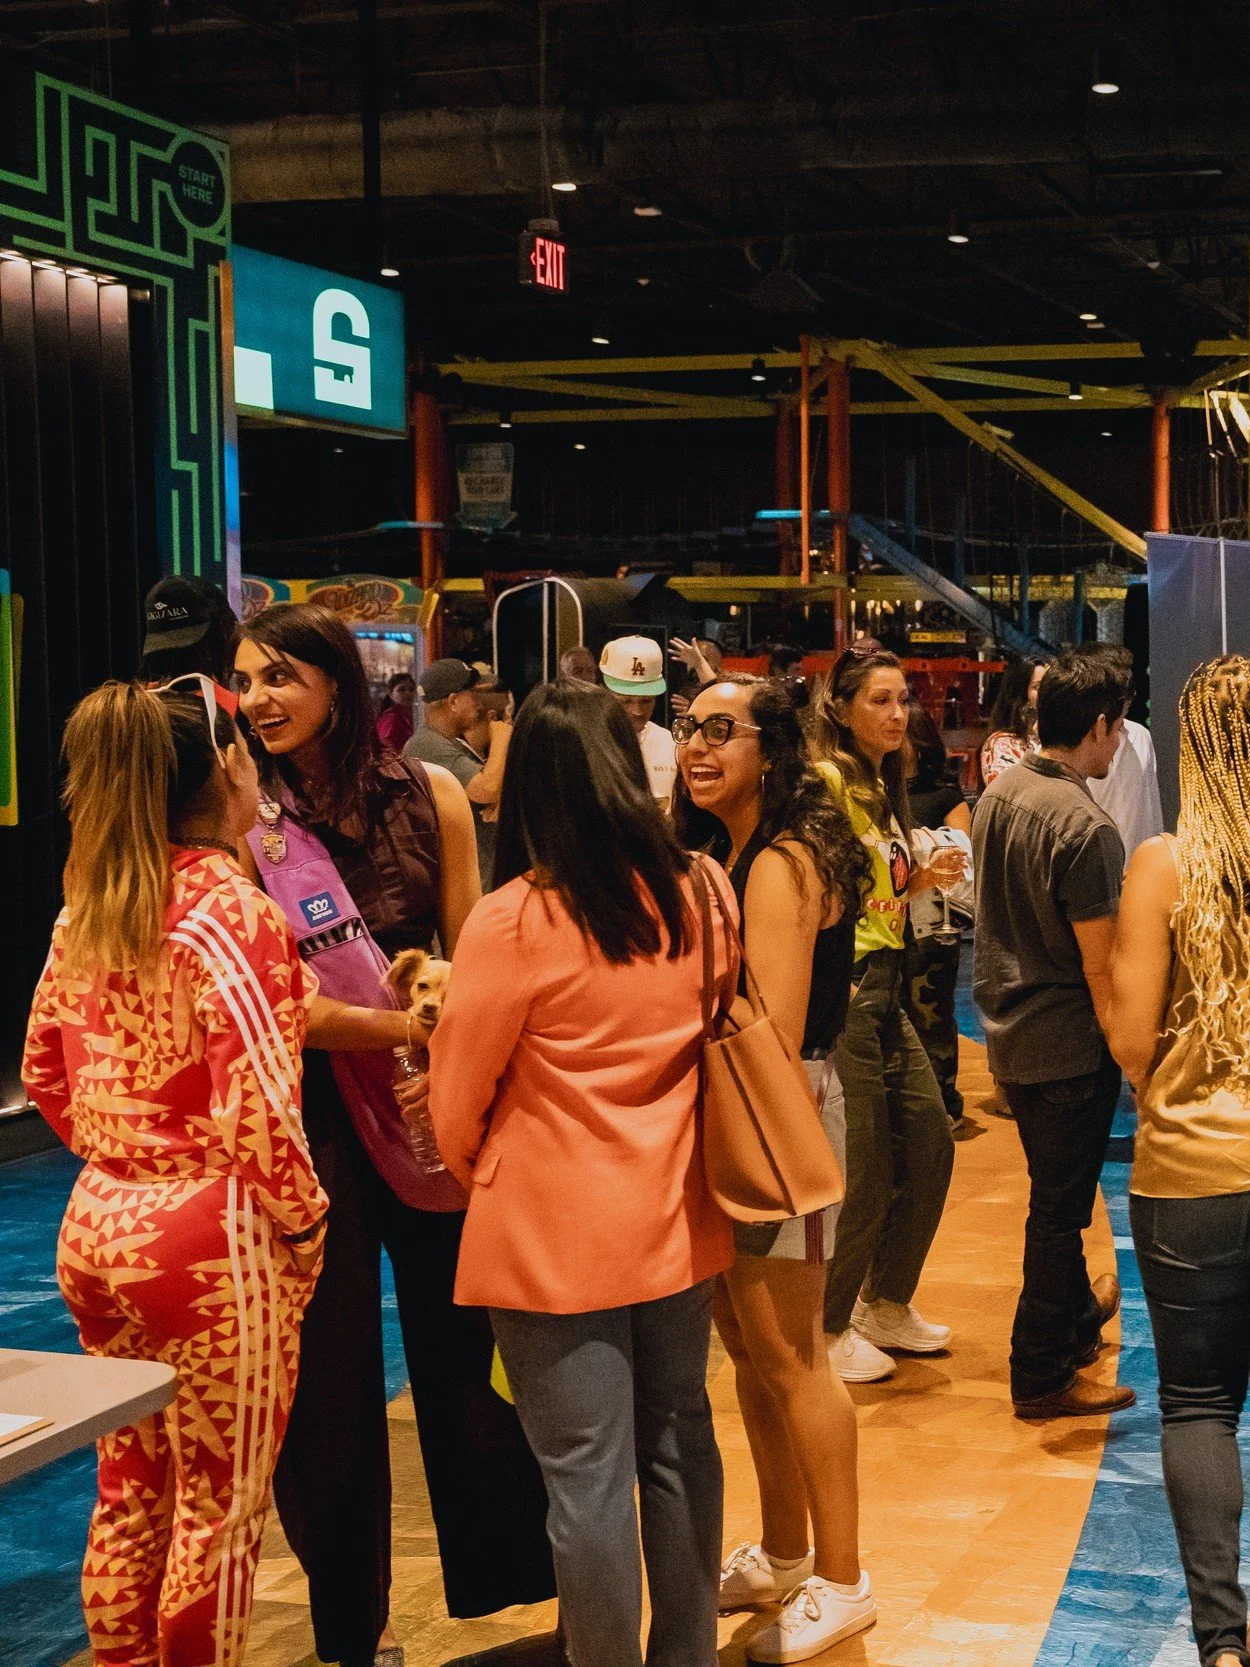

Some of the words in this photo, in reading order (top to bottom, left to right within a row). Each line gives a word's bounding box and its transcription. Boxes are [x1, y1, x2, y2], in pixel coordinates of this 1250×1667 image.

[179, 164, 215, 188] START
[183, 182, 213, 205] HERE
[536, 237, 565, 290] EXIT
[631, 656, 646, 677] LA
